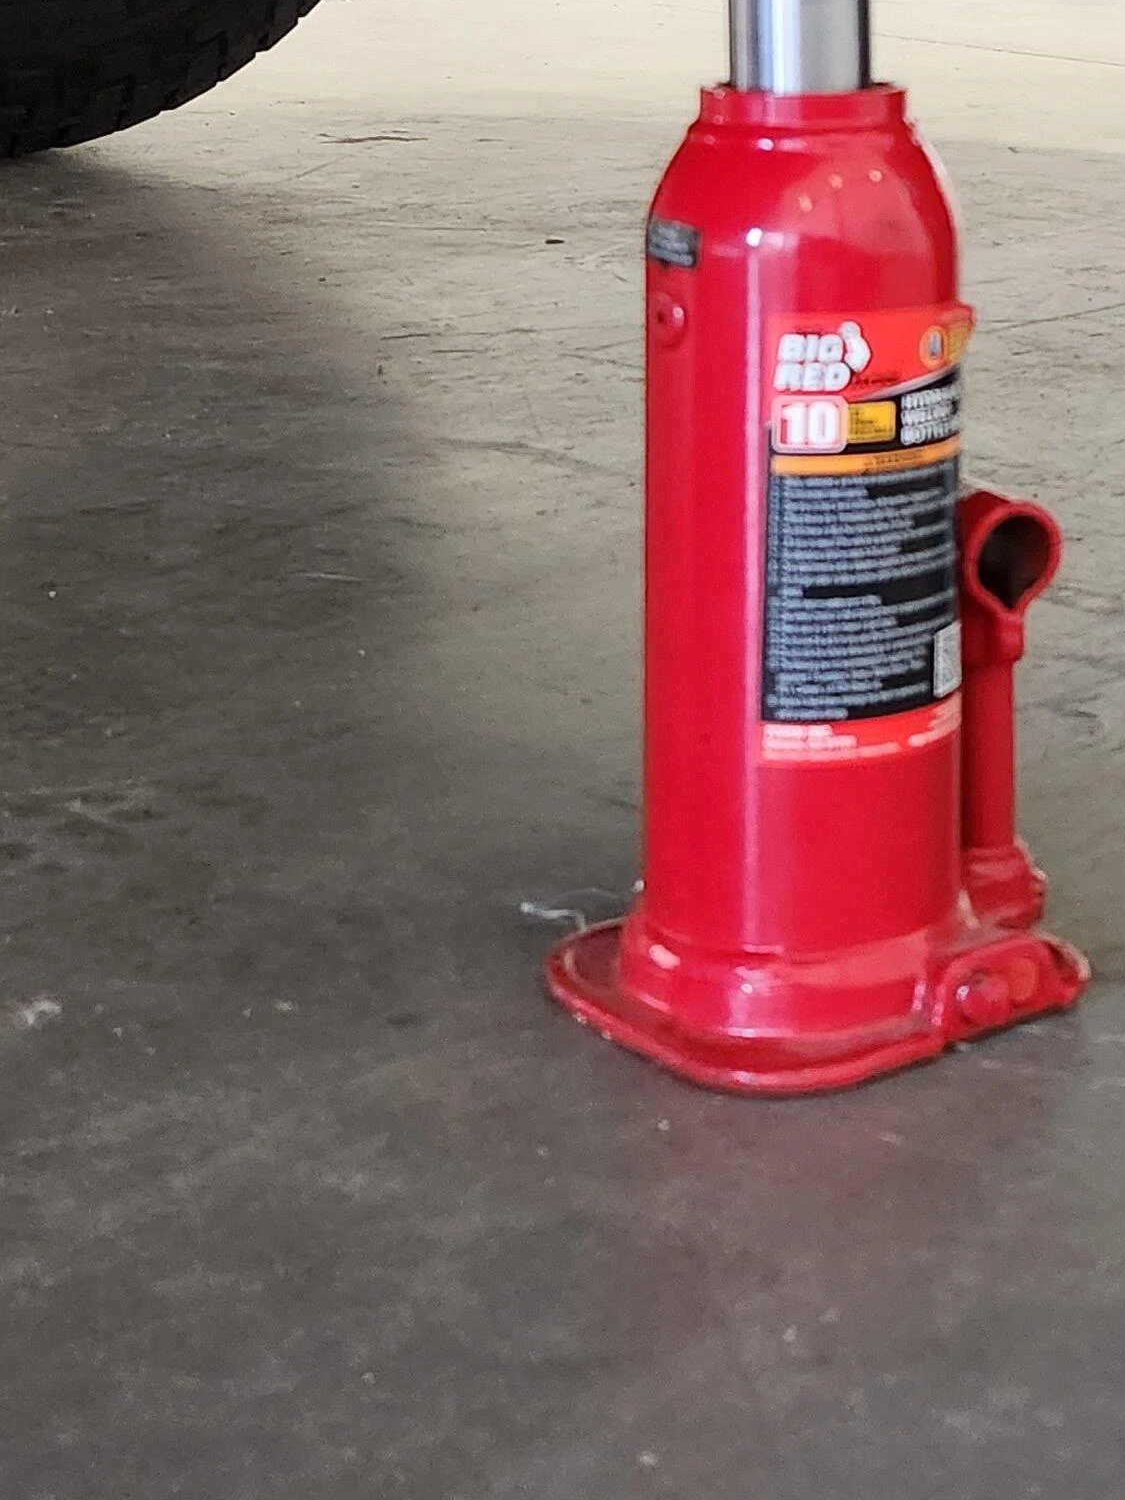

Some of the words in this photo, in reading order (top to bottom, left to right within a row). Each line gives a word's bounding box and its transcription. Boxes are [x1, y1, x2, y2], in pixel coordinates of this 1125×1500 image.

[777, 333, 844, 362] BIG
[773, 362, 851, 392] RED
[781, 400, 840, 446] 10
